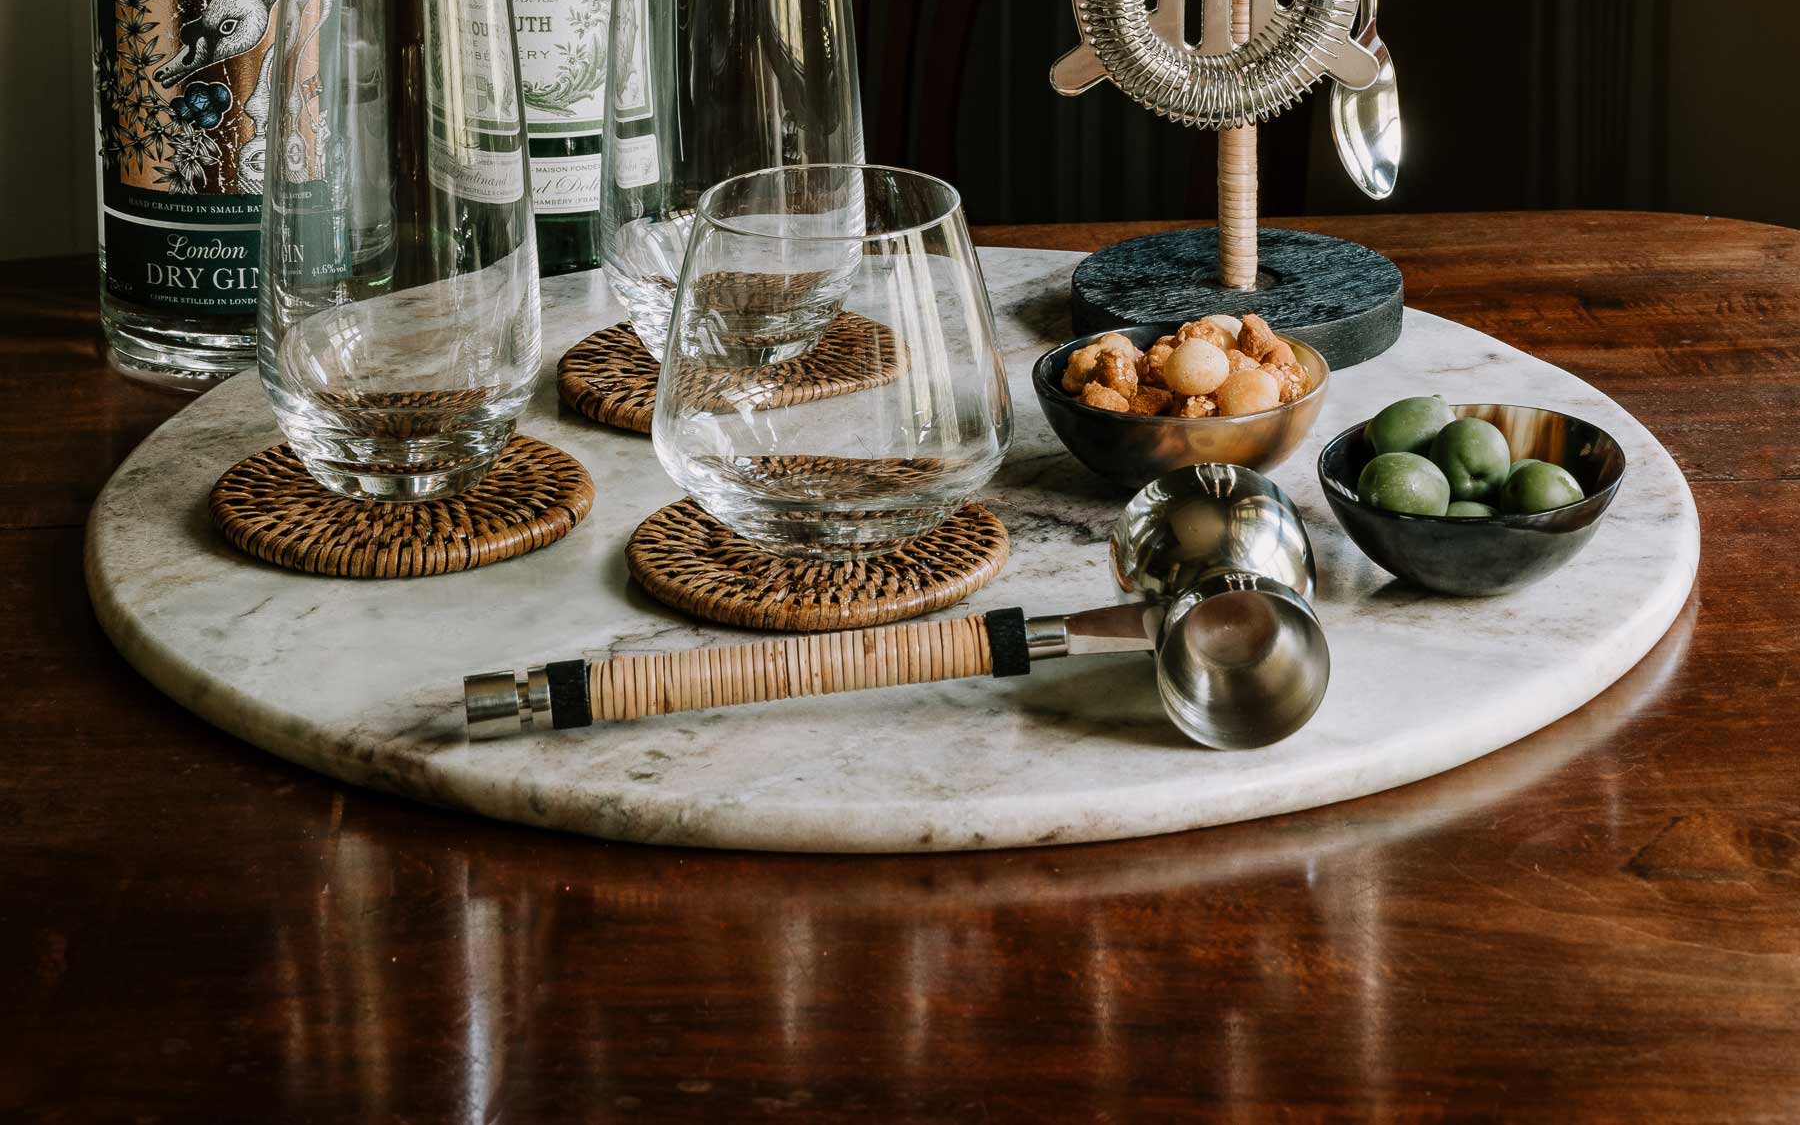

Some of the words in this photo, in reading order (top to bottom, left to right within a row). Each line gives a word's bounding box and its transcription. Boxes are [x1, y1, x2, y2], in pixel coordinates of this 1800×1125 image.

[151, 202, 194, 214] CRAFTED
[210, 206, 244, 214] SMALL
[166, 234, 248, 261] London
[147, 263, 204, 290] DRY
[180, 297, 215, 306] STILLED
